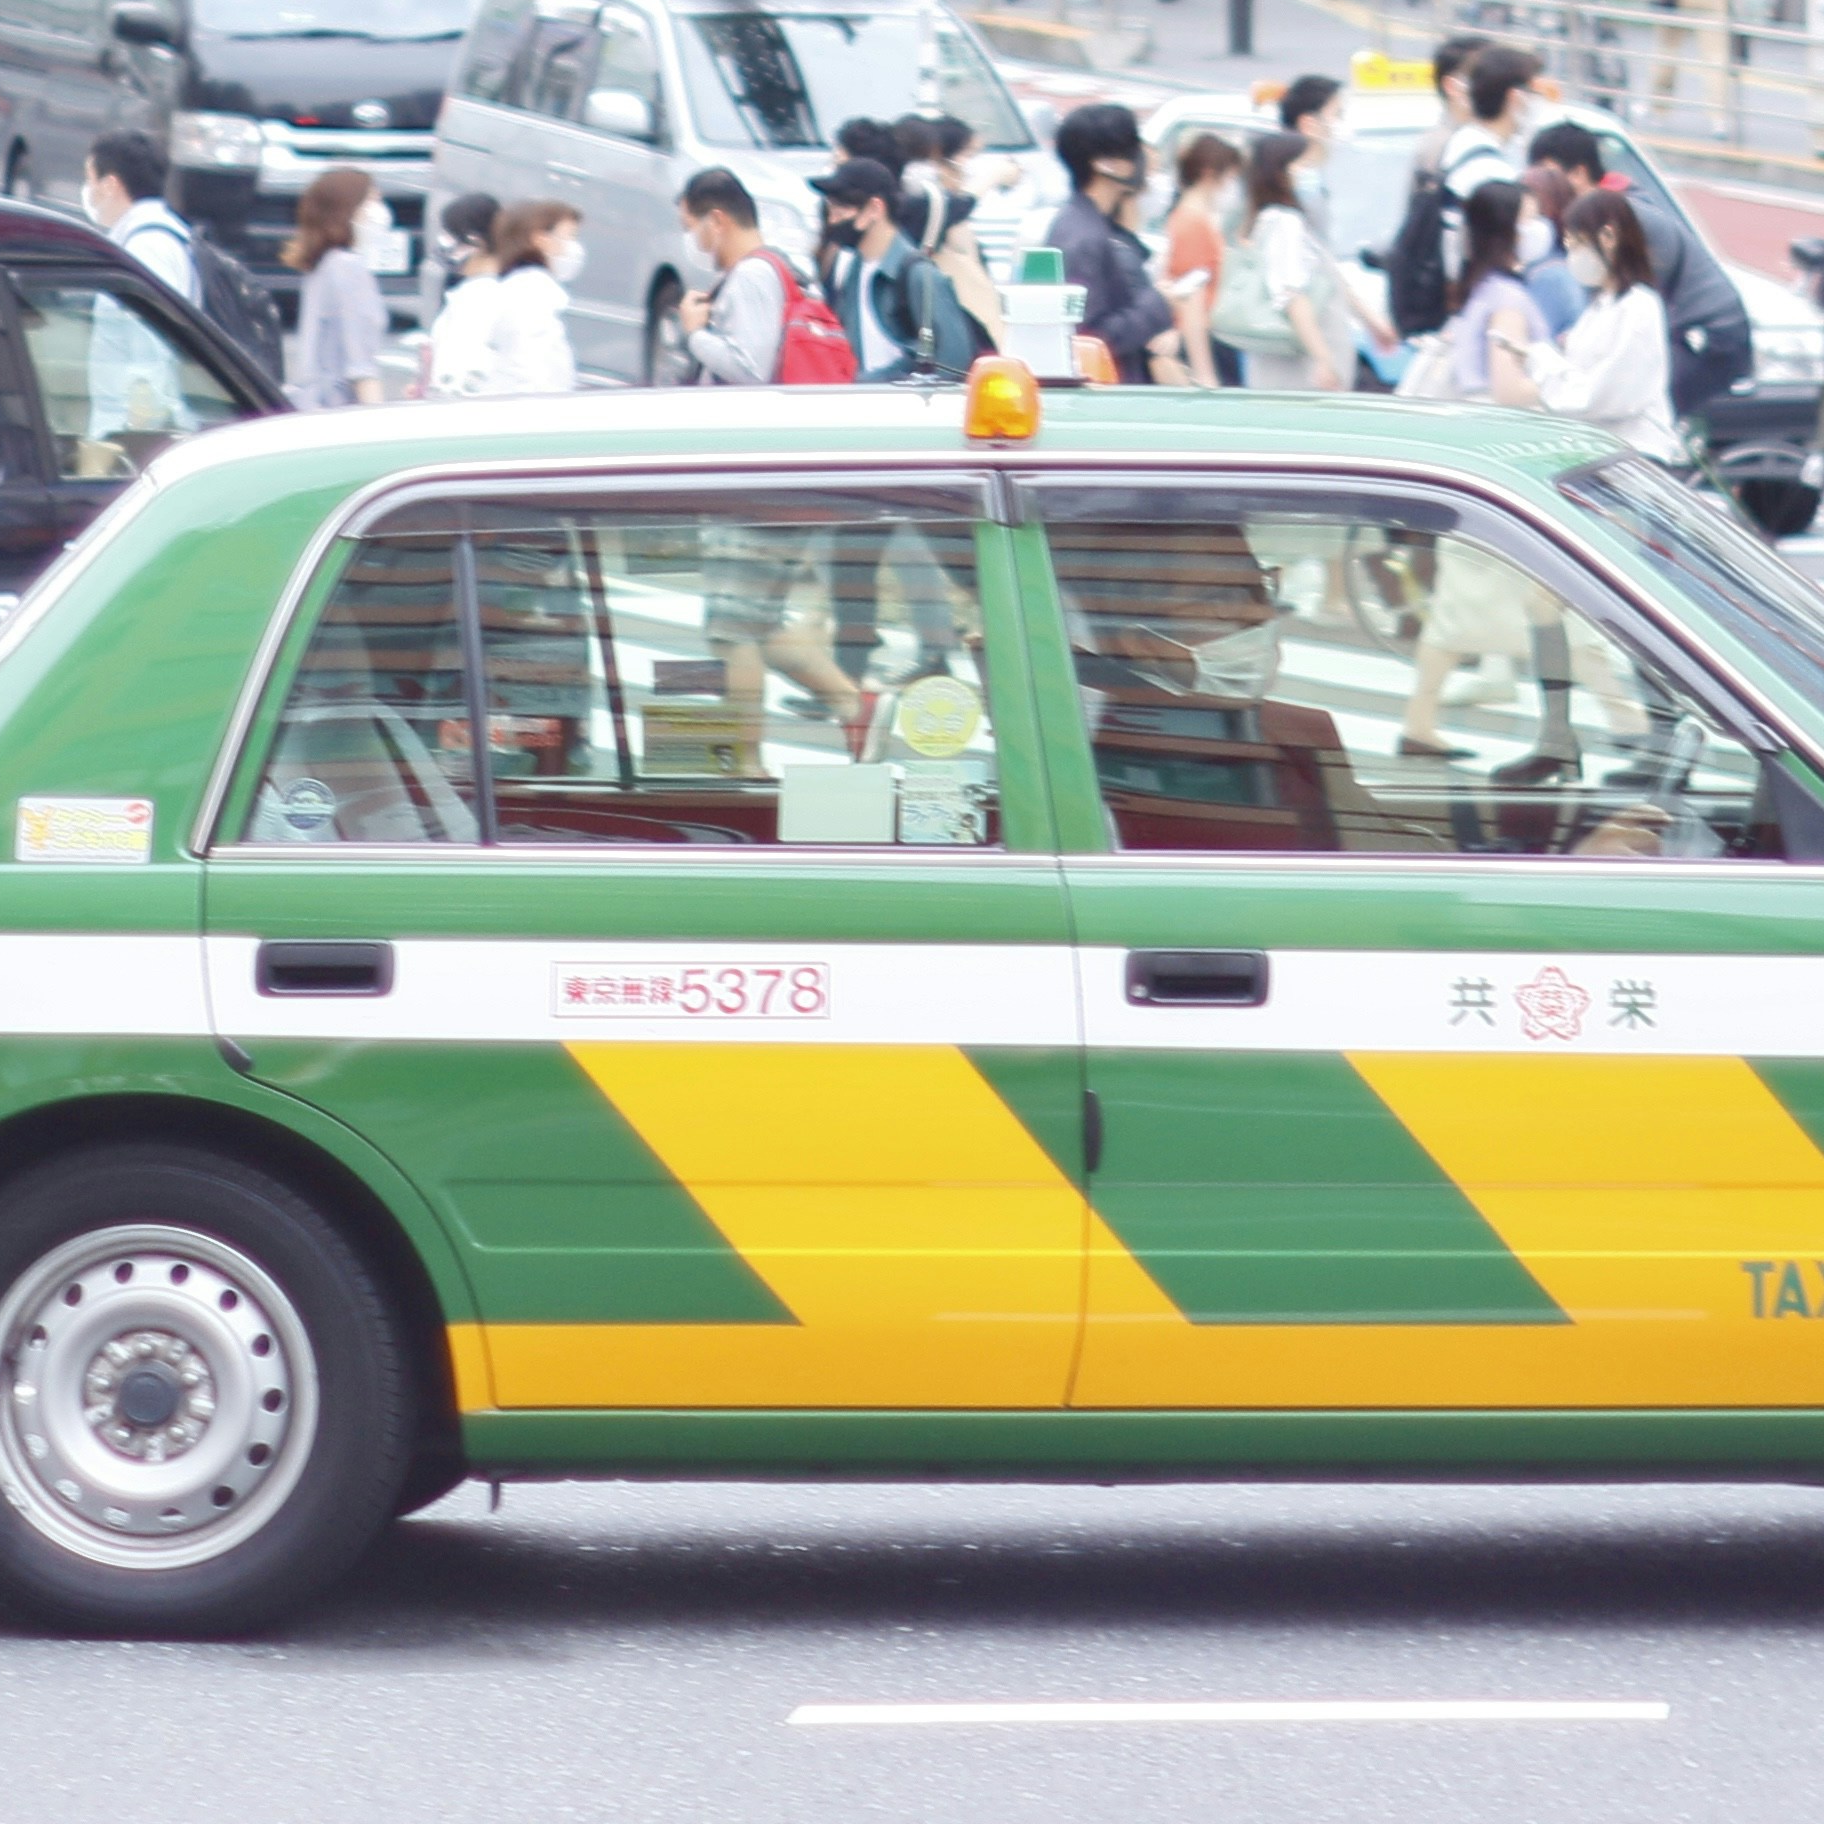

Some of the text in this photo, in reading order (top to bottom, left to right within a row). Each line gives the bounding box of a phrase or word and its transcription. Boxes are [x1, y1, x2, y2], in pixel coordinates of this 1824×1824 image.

[680, 967, 826, 1015] 5378
[1448, 976, 1497, 1028] 共
[1606, 979, 1659, 1030] 栄
